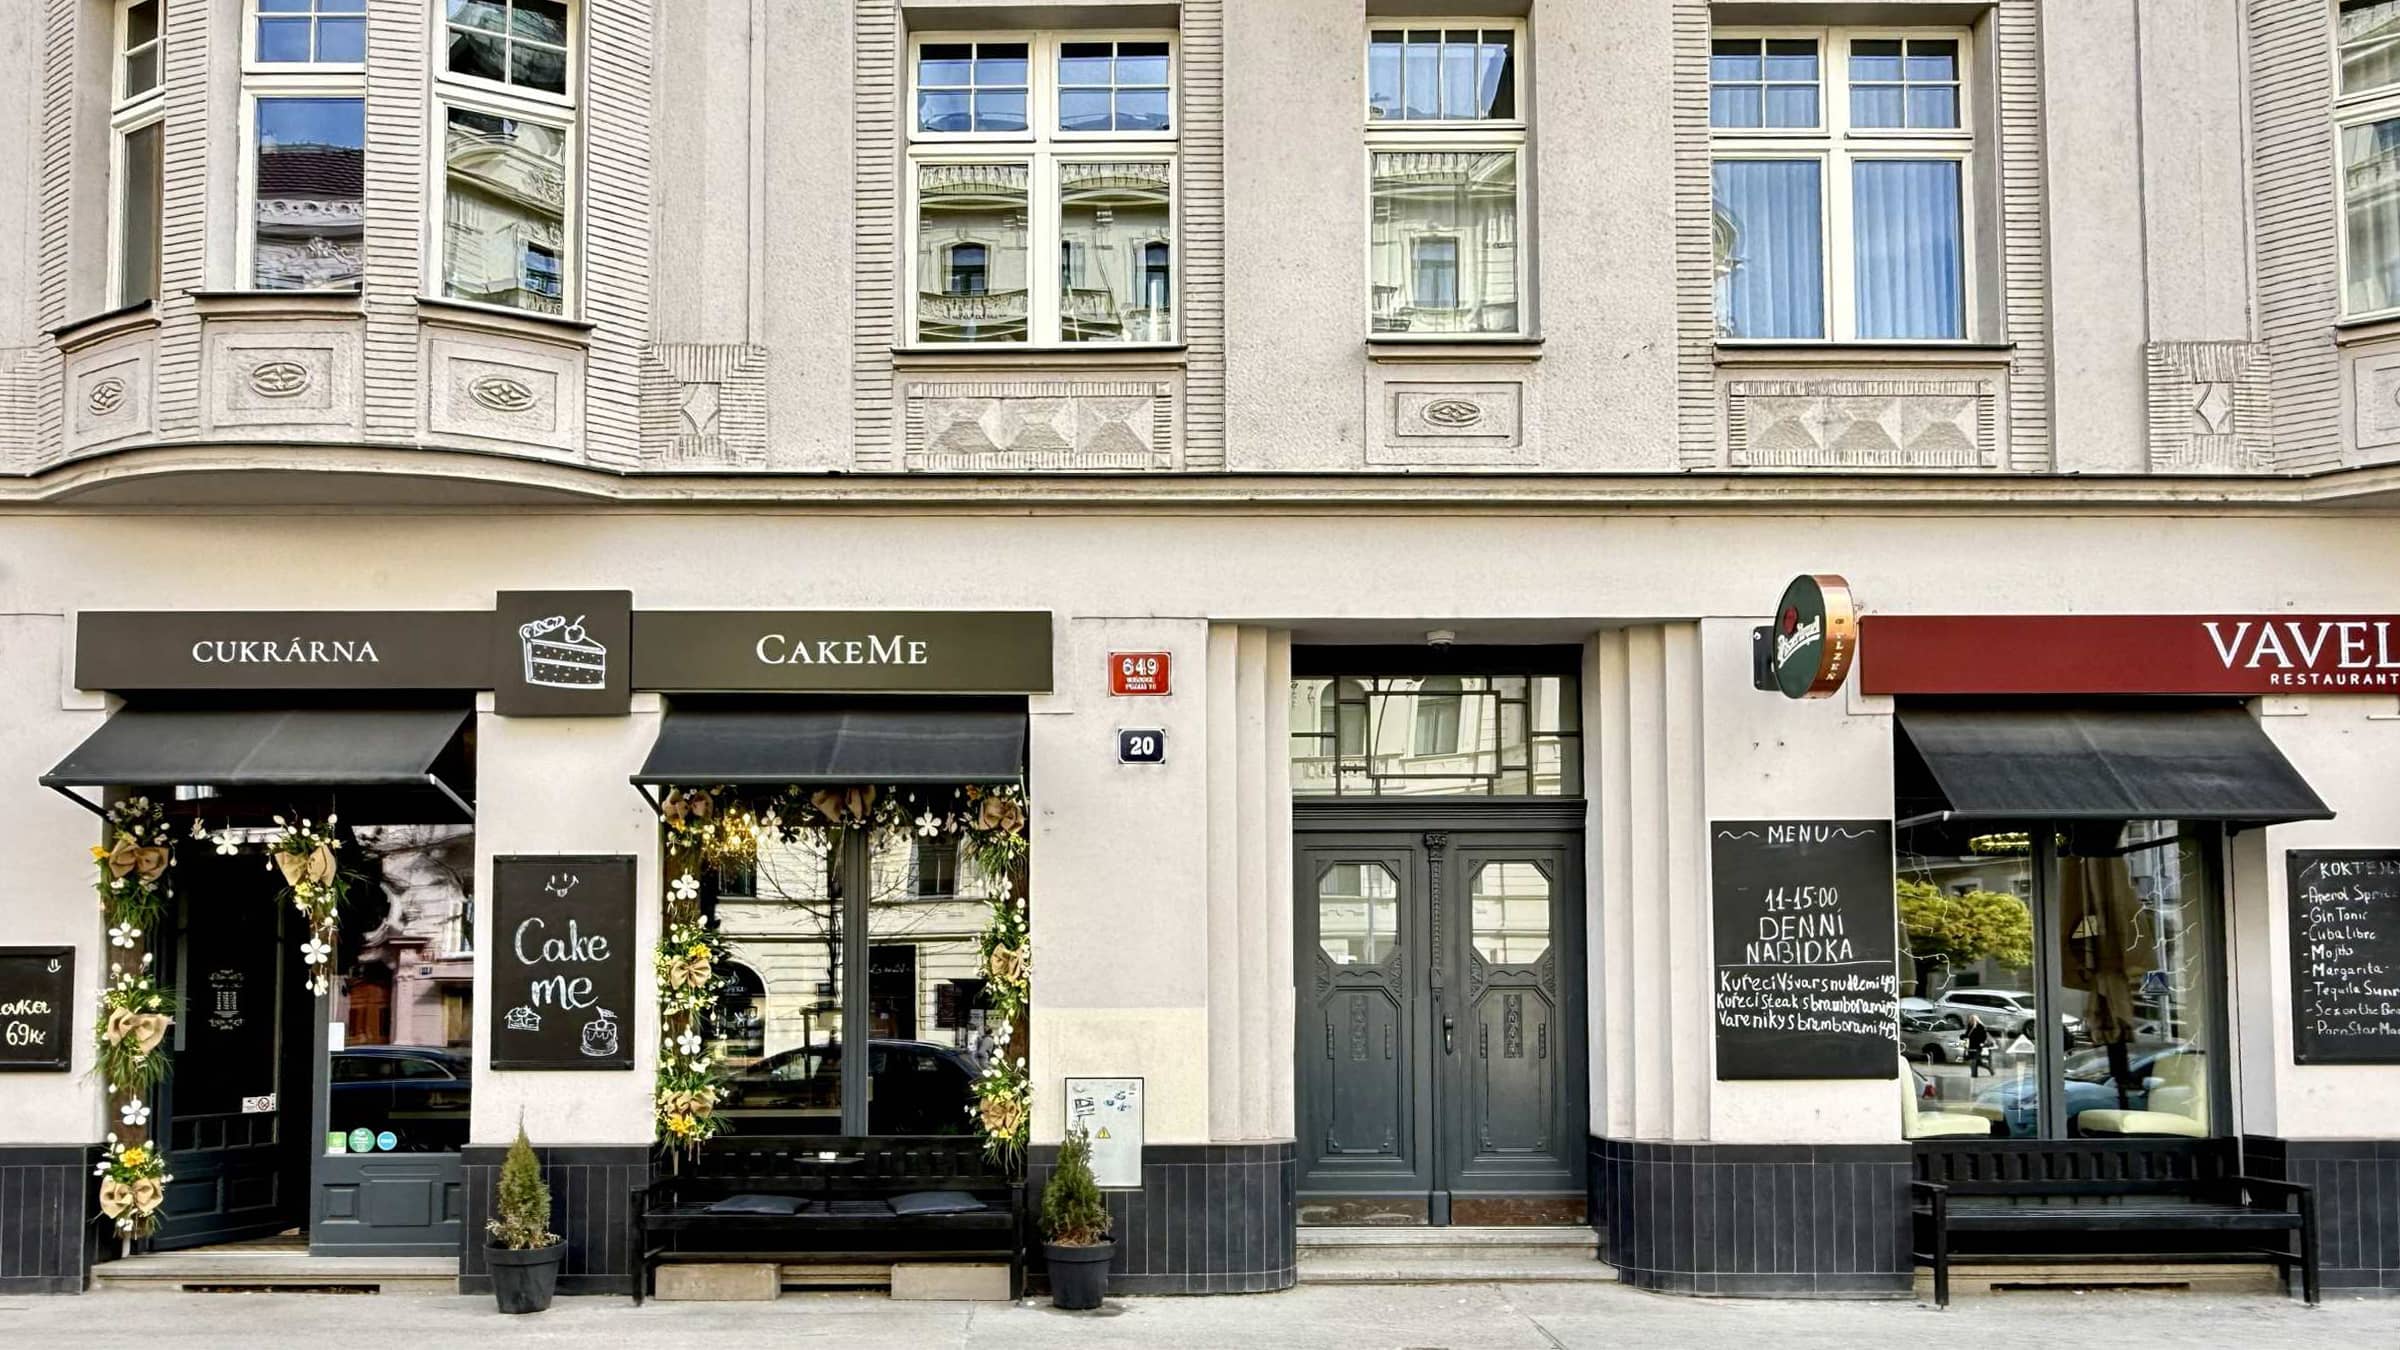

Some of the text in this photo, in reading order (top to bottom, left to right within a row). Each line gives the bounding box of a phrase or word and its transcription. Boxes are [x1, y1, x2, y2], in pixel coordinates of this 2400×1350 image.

[192, 636, 380, 663] CUKRÁRNA
[2202, 621, 2400, 669] VAVEL
[1122, 657, 1159, 675] 649
[2270, 672, 2399, 686] RESTAURANT
[1130, 736, 1154, 756] 20
[1767, 824, 1829, 844] MENU
[1759, 908, 1844, 941] DENNÍ
[514, 917, 611, 965] Cake
[531, 974, 599, 1011] me
